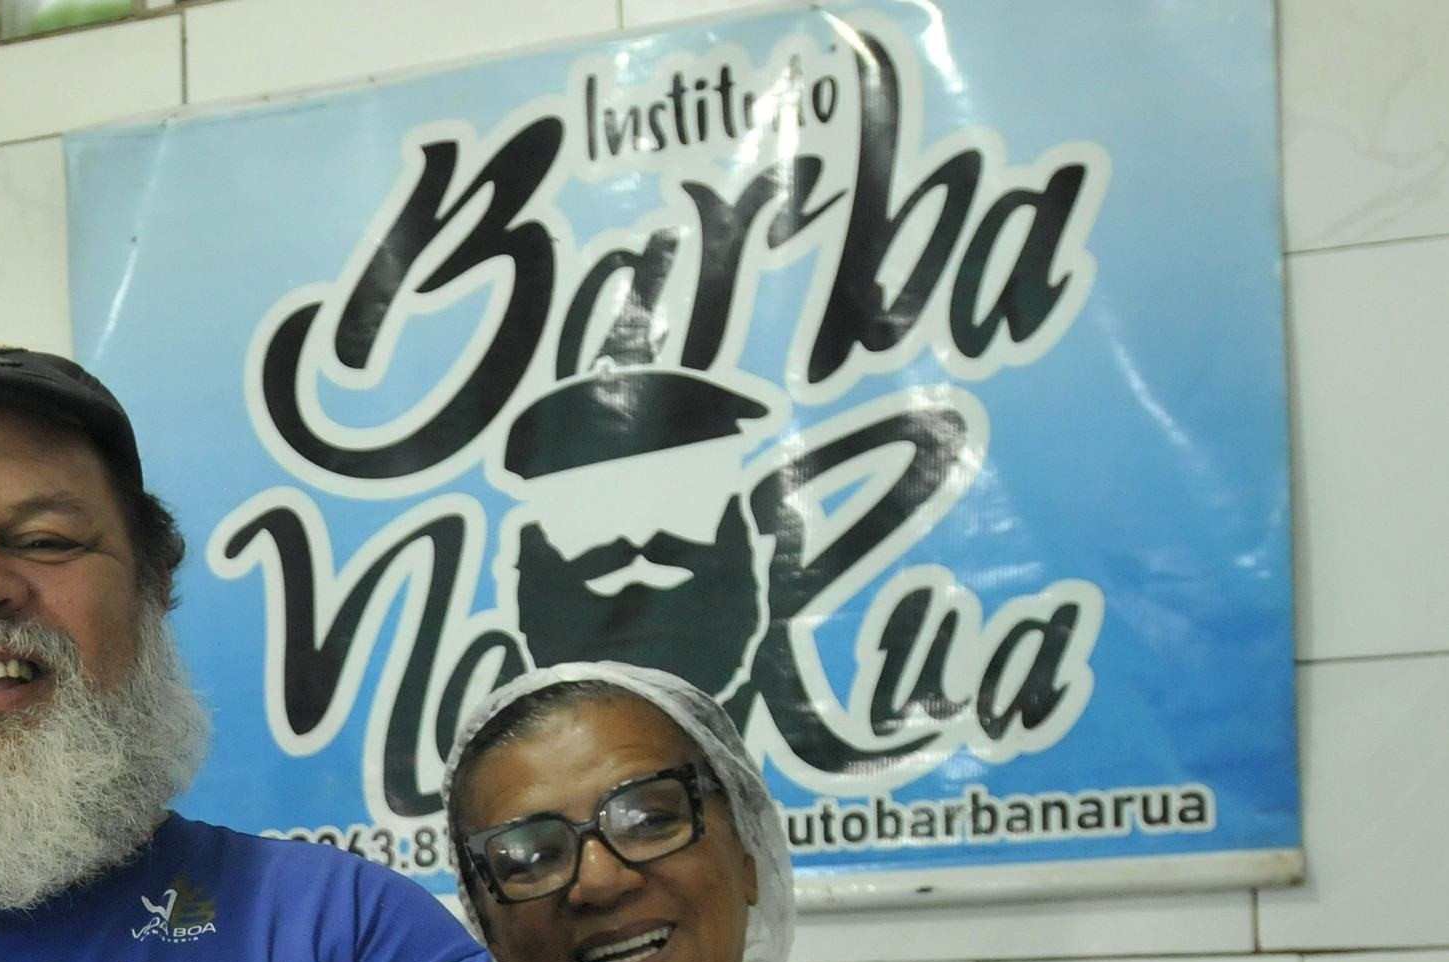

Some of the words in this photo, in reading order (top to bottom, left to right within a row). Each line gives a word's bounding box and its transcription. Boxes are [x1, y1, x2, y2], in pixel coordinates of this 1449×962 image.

[261, 30, 1087, 480] Barba
[718, 407, 1081, 775] Rua
[172, 922, 217, 938] BOA
